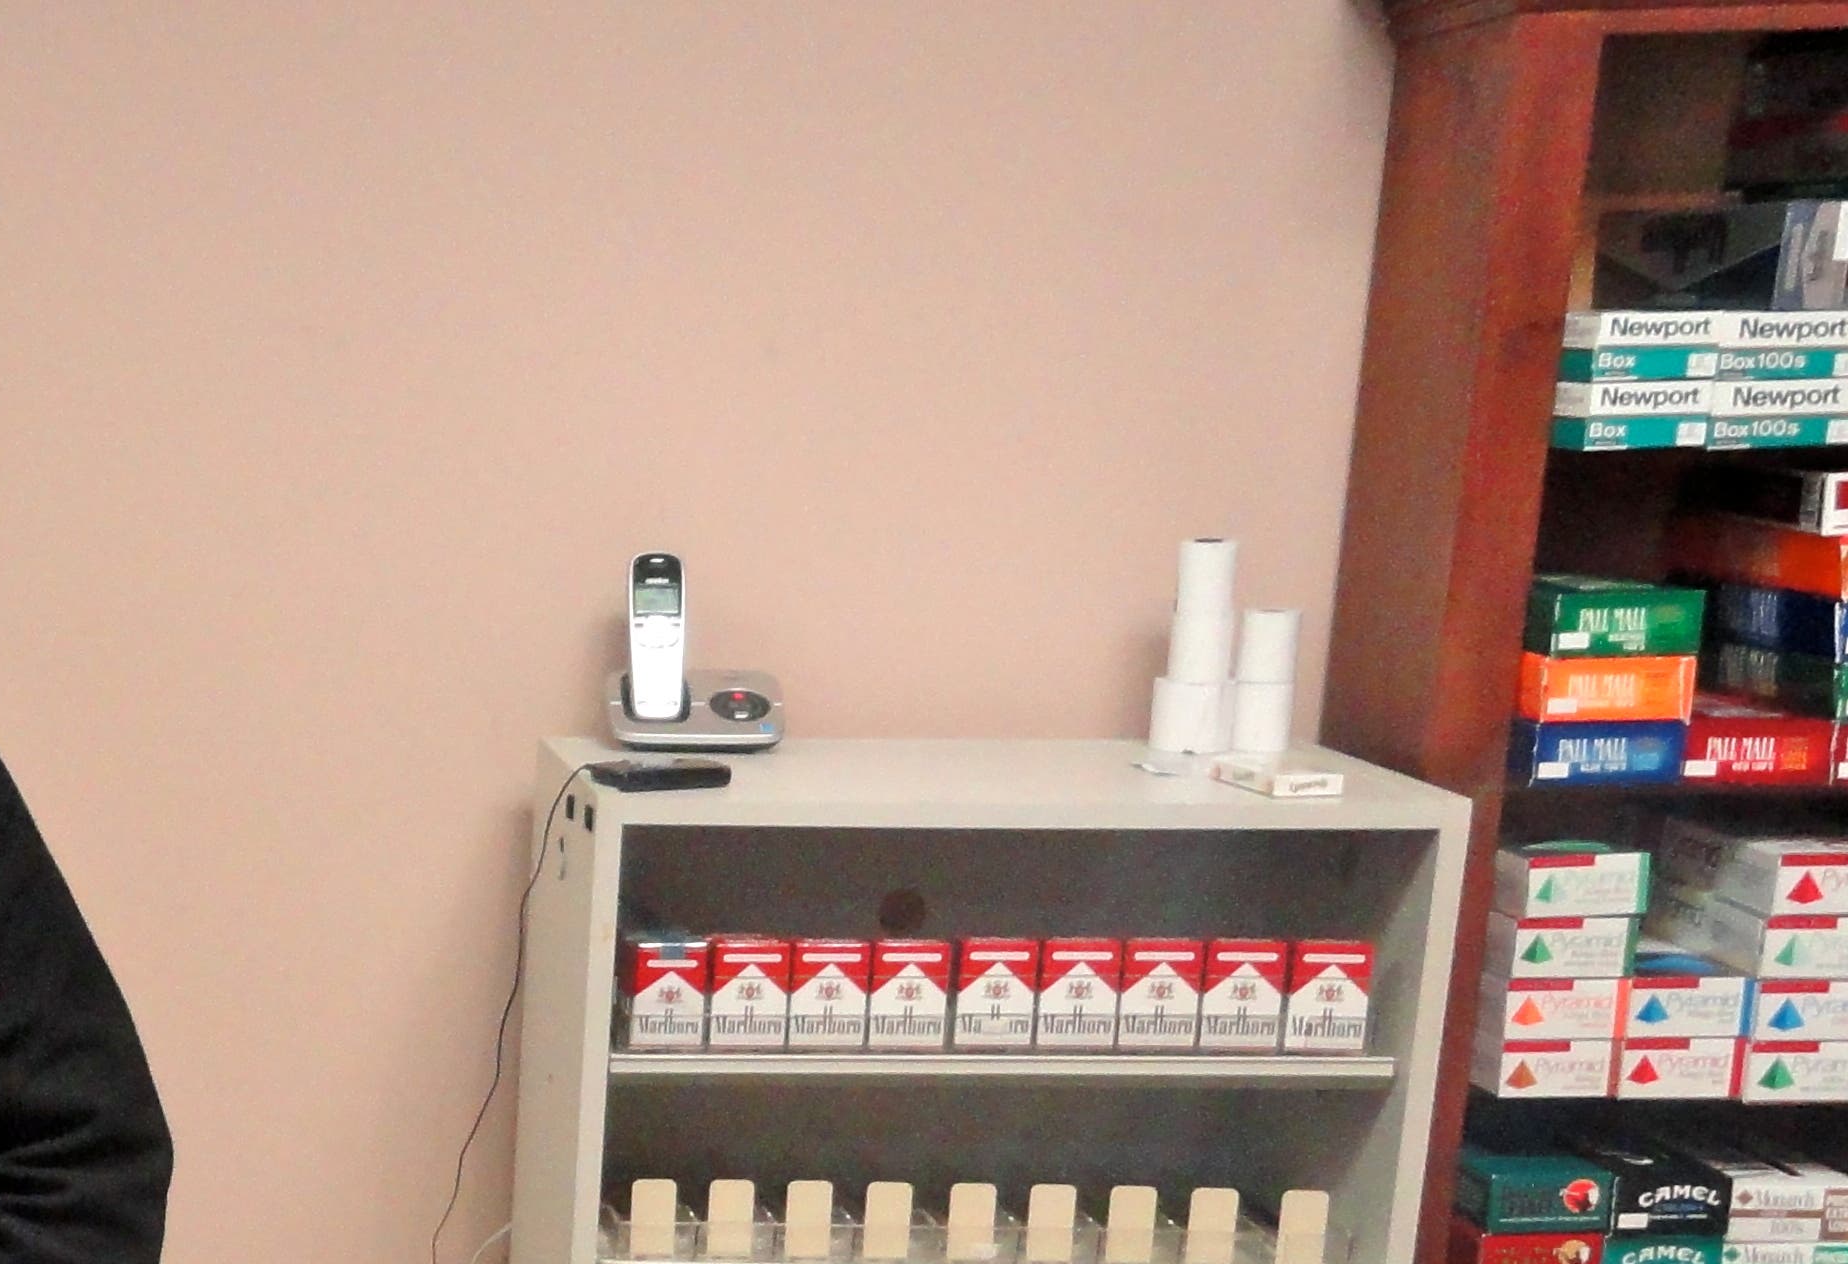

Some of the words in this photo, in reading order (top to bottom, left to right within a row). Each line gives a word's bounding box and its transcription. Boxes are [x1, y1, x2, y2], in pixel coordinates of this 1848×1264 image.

[1610, 317, 1712, 339] Newport
[1739, 317, 1847, 340] Newport
[1598, 353, 1635, 369] Box
[1601, 386, 1700, 409] Newport
[1732, 386, 1841, 409] Newport
[1589, 422, 1627, 438] Box
[1578, 608, 1609, 633] PALL
[1613, 607, 1646, 632] MALL
[1558, 738, 1588, 762] PALL
[1594, 738, 1627, 762] MALL
[1706, 737, 1737, 761] PALL
[1742, 737, 1776, 761] MALL
[716, 1006, 782, 1035] Marlboro
[793, 1005, 861, 1035] Marlboro
[874, 1006, 942, 1035] Marlboro
[1043, 1005, 1112, 1035] Marlboro
[1124, 1005, 1193, 1035] Marlboro
[1206, 1006, 1276, 1036] Marlboro
[1293, 1007, 1362, 1038] Marlboro
[1638, 1184, 1721, 1207] CAMEL
